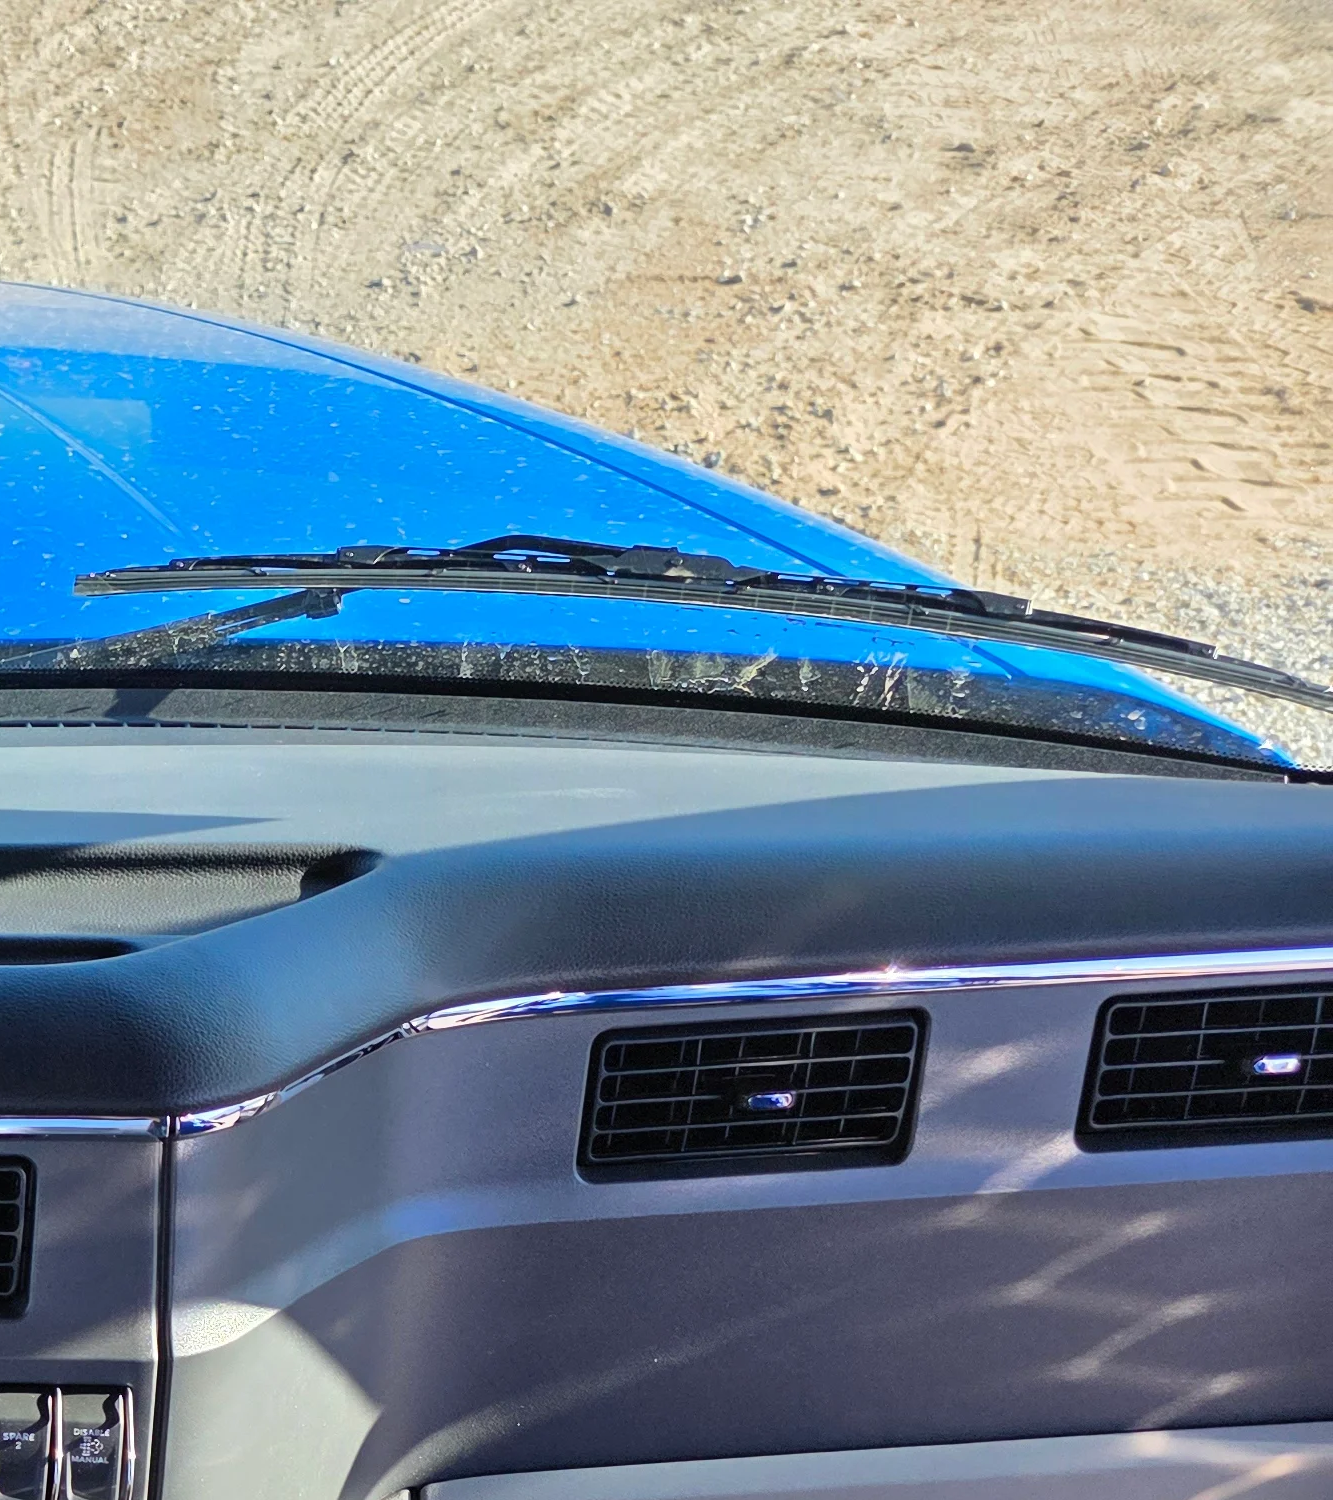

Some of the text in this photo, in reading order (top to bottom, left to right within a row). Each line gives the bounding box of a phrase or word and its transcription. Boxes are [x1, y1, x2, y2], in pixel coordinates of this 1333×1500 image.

[73, 1427, 110, 1437] DISABLE
[3, 1432, 35, 1442] SPARE
[15, 1441, 22, 1450] 2
[71, 1455, 109, 1464] MANUAL
